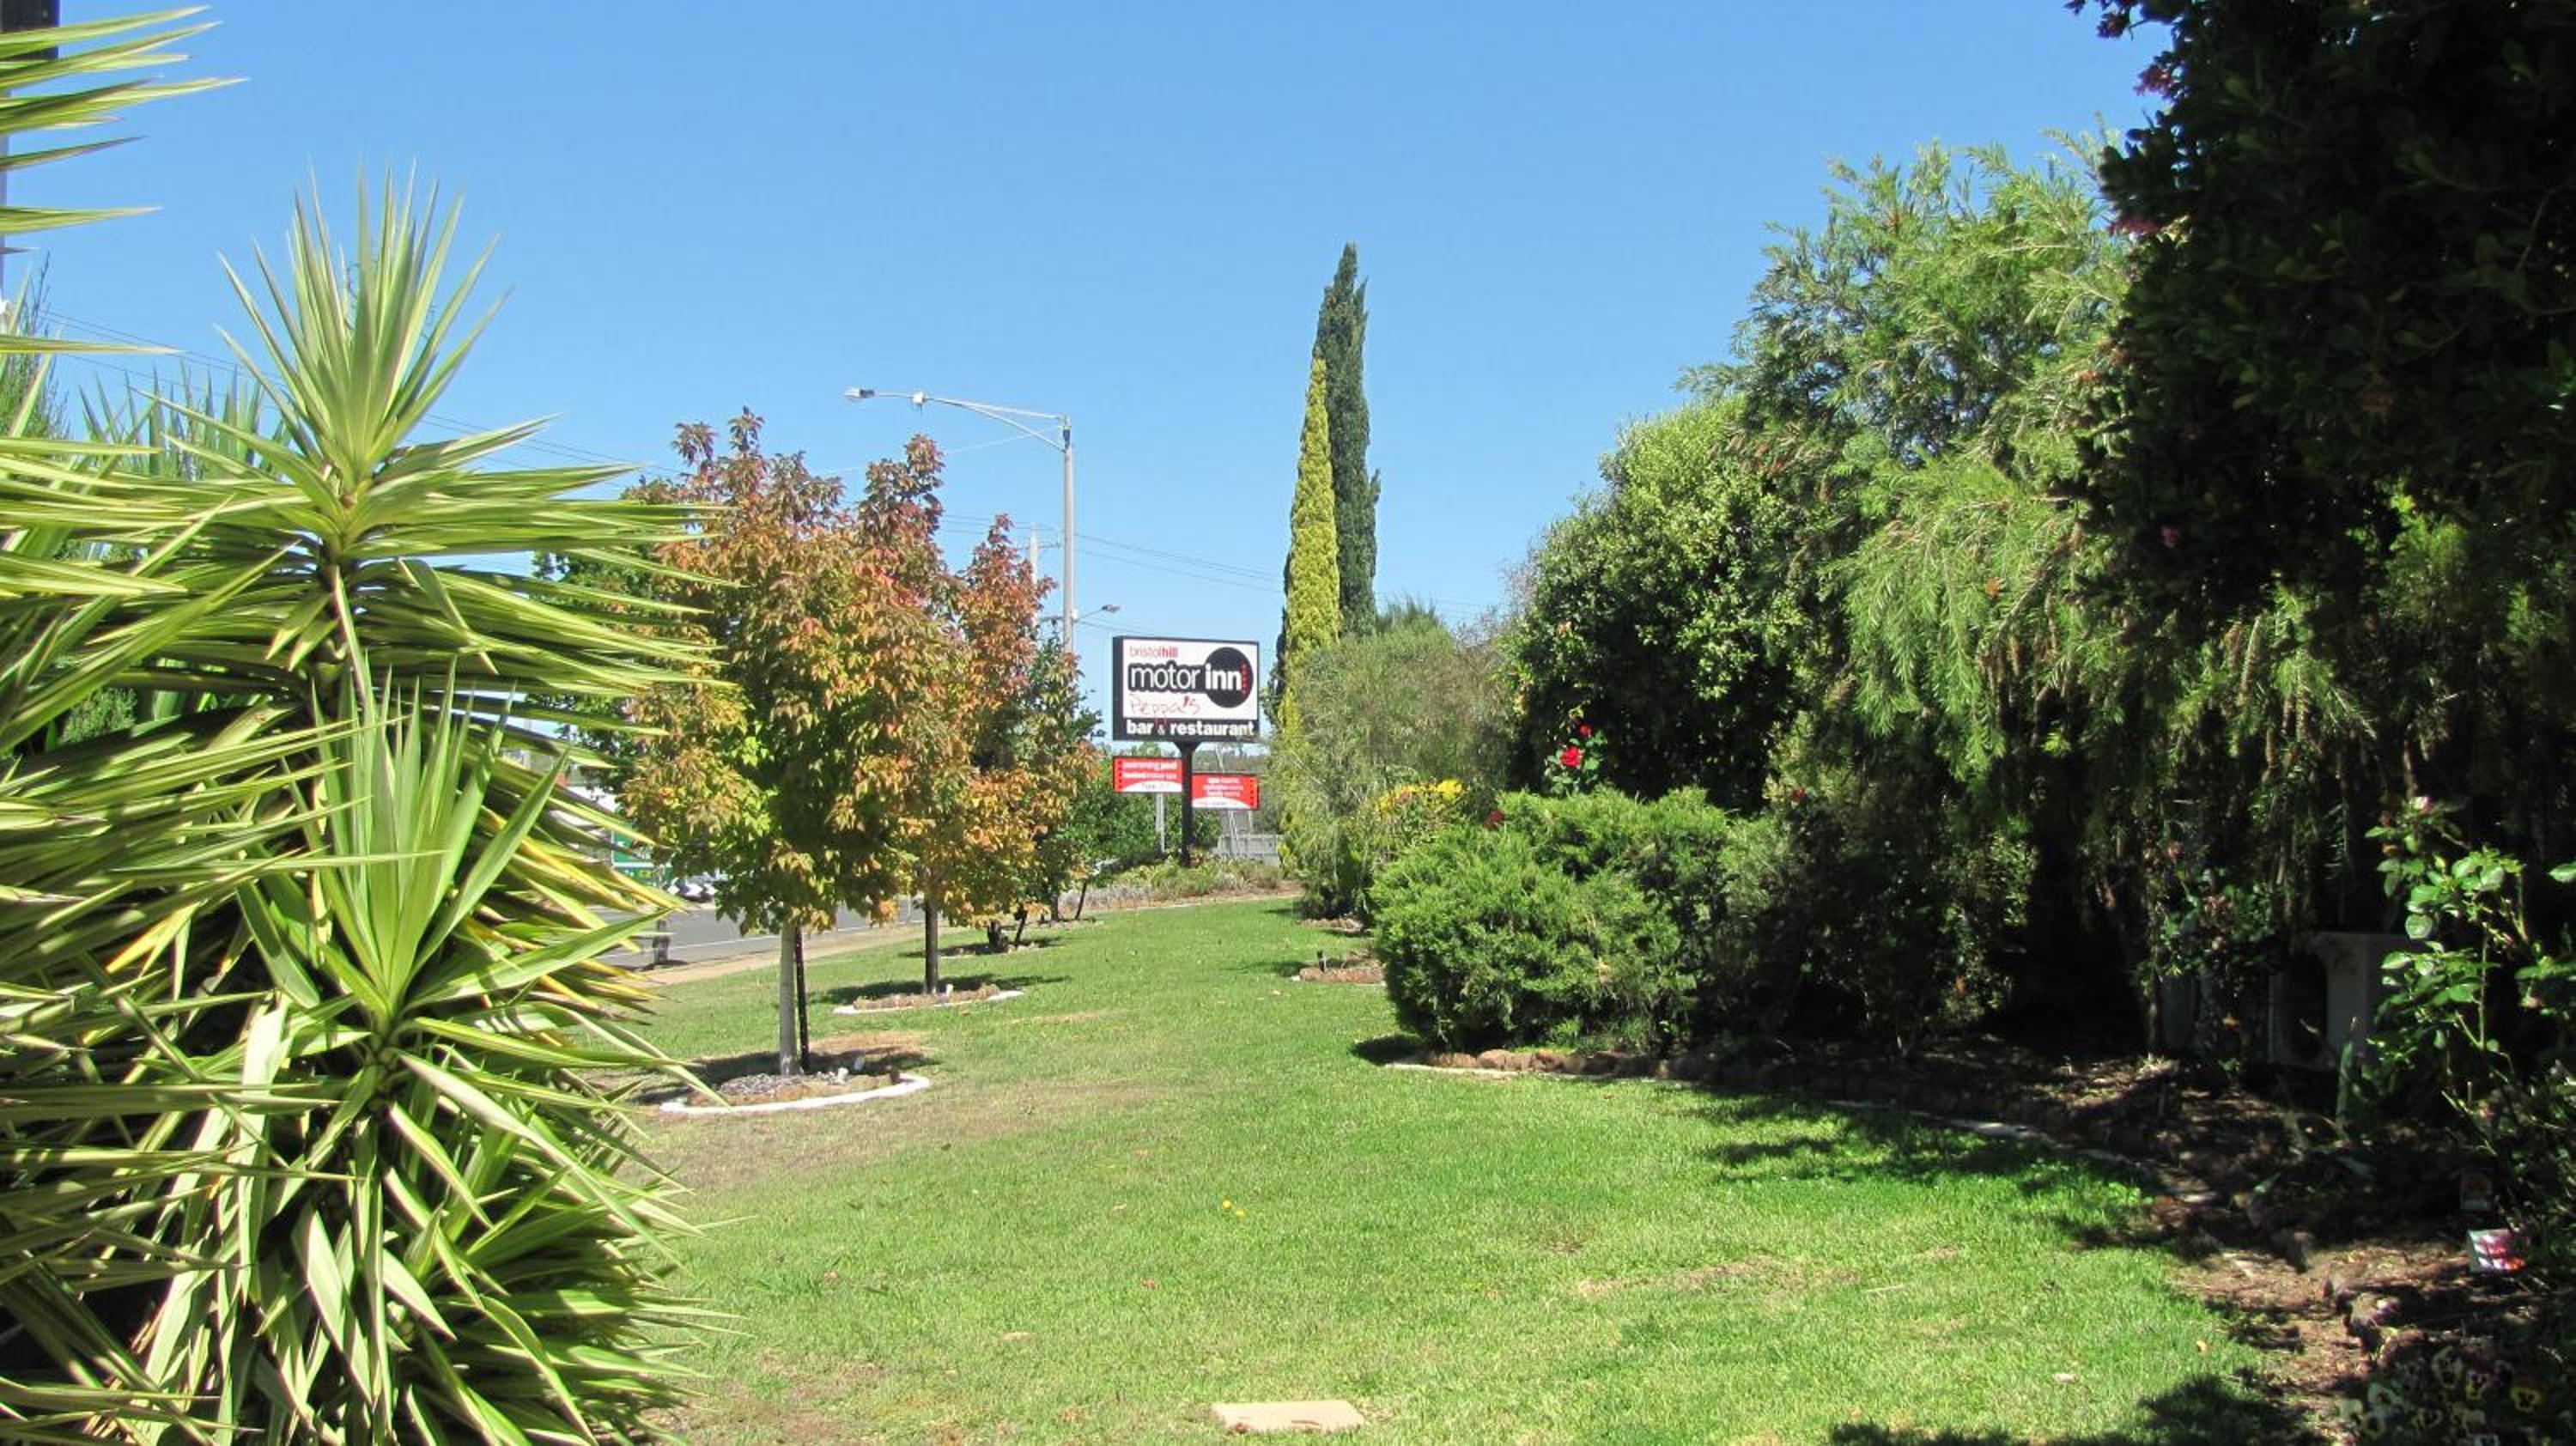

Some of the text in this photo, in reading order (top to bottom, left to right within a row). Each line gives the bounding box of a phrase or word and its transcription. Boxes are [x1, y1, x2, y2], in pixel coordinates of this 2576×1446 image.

[1130, 663, 1242, 691] motor inn
[1126, 719, 1154, 735] bar
[1170, 720, 1255, 737] restaurant
